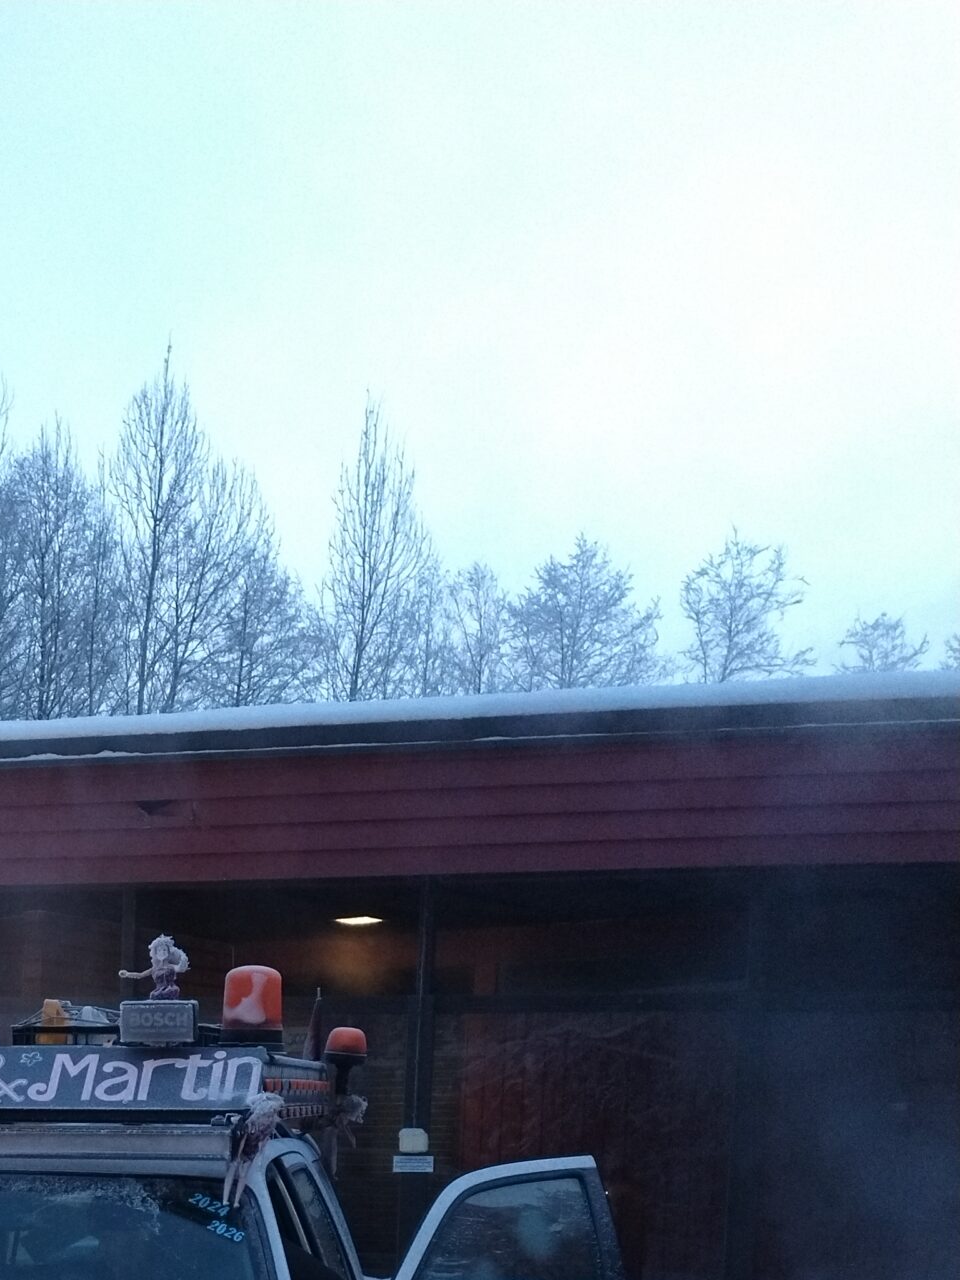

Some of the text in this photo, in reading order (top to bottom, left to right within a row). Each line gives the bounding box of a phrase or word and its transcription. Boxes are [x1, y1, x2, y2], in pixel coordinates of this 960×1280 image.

[129, 1011, 189, 1028] BOSCH
[188, 1193, 230, 1217] 2024
[206, 1220, 245, 1242] 2026
